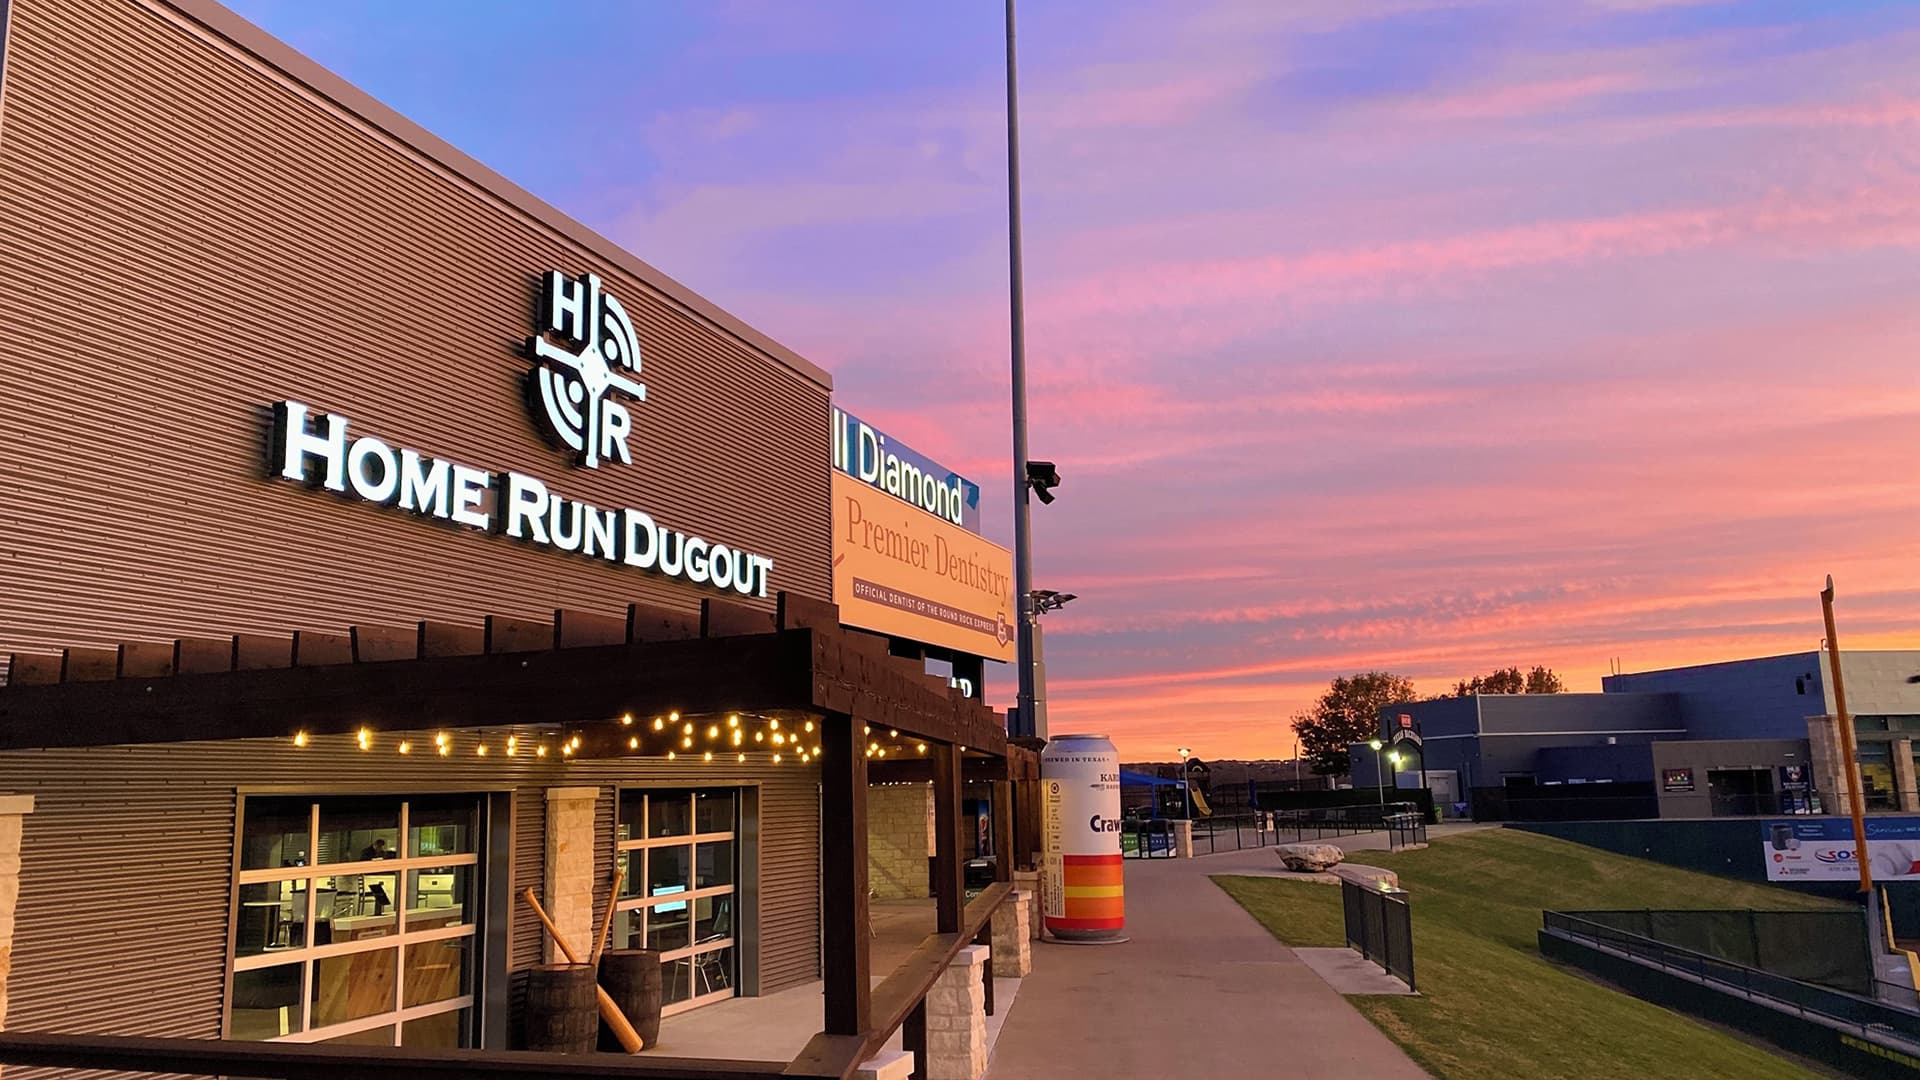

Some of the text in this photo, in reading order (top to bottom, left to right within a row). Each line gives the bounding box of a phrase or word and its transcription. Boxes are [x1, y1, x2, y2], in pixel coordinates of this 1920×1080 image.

[552, 269, 585, 341] H
[602, 398, 632, 466] R
[859, 421, 963, 526] Diamond
[281, 400, 774, 599] HOME RUN DUGOUT
[846, 496, 1009, 608] Premier Dentistry
[854, 583, 995, 632] OFFICIAL DENTIST OF THE ROUND ROCK EXPRESS
